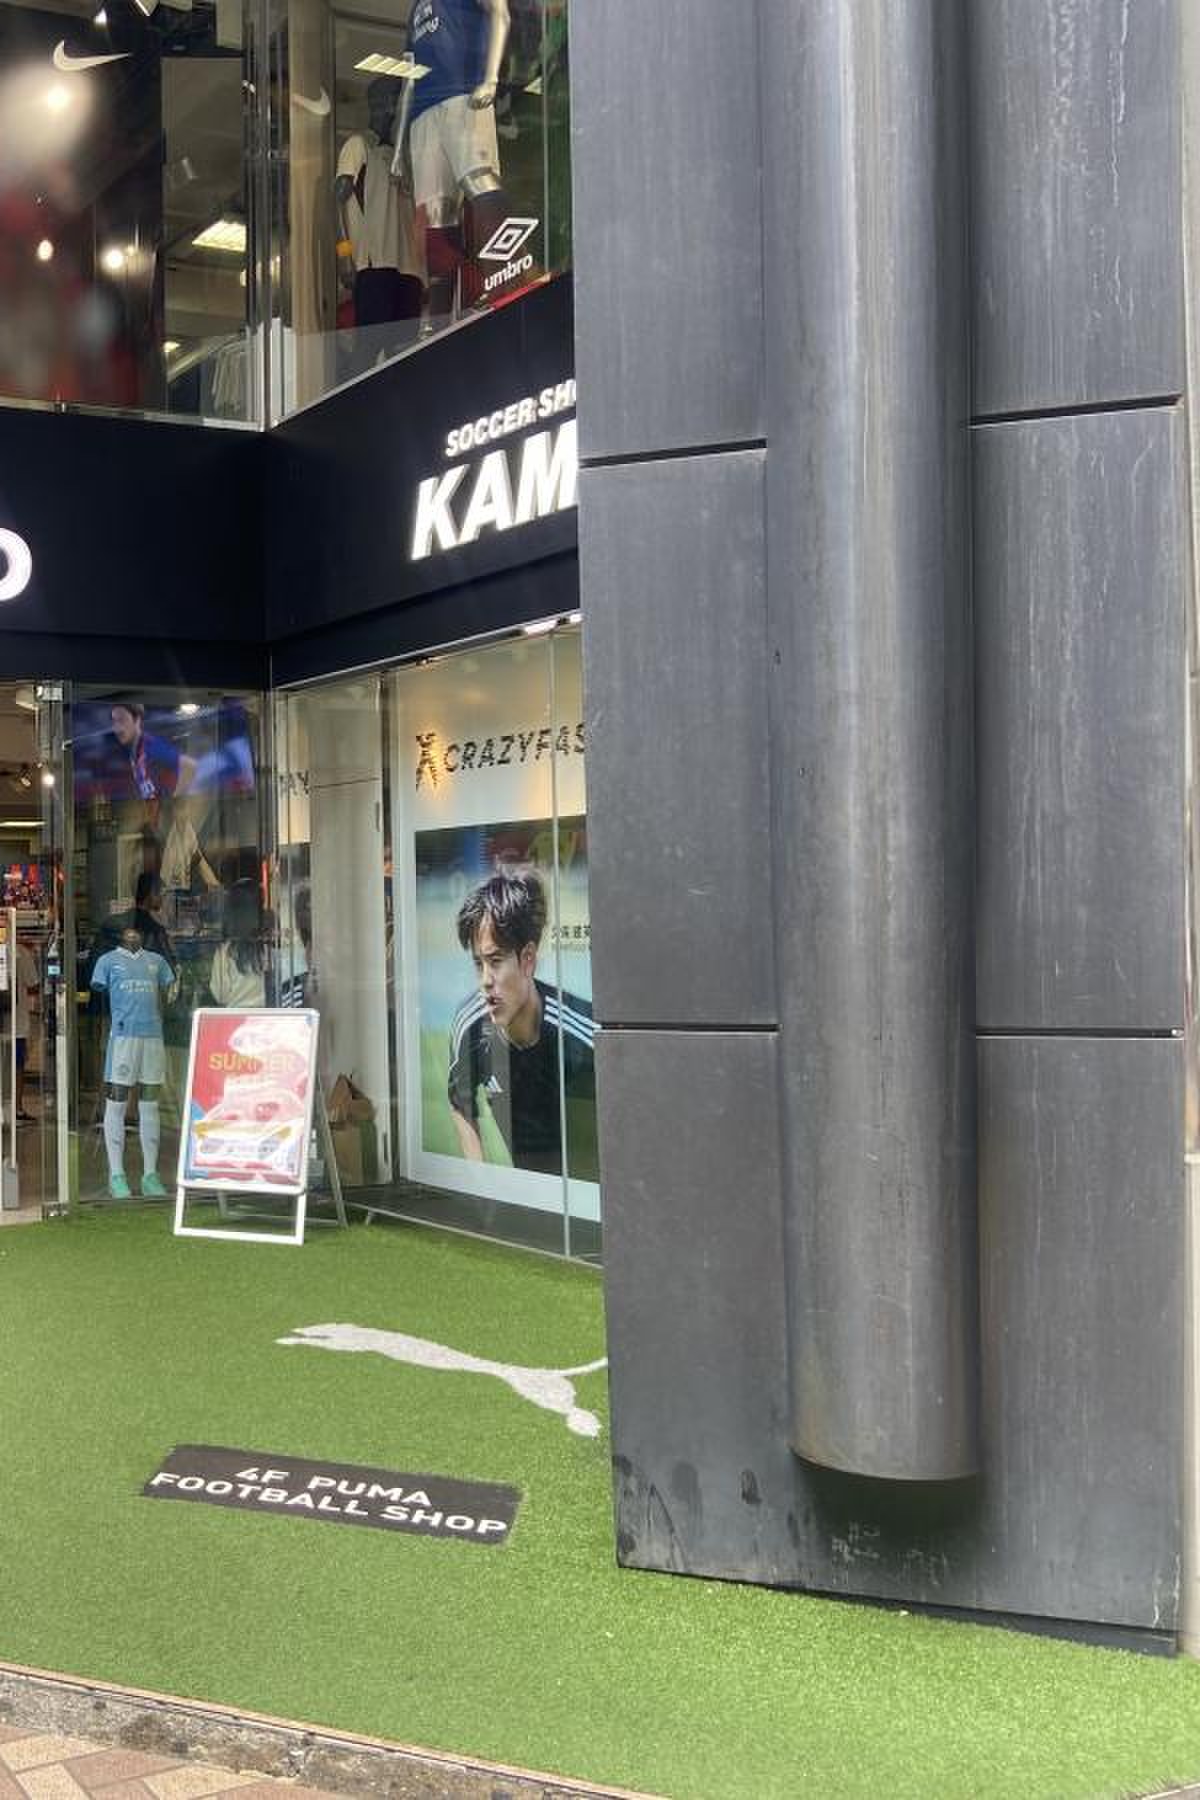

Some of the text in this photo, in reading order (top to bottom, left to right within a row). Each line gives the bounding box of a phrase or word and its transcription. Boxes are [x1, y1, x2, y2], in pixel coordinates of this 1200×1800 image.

[484, 253, 534, 291] umbro
[444, 379, 577, 458] SOCCER SH
[149, 1472, 509, 1536] FOOTBALL SHOP
[235, 1467, 433, 1508] 4F PUMA
